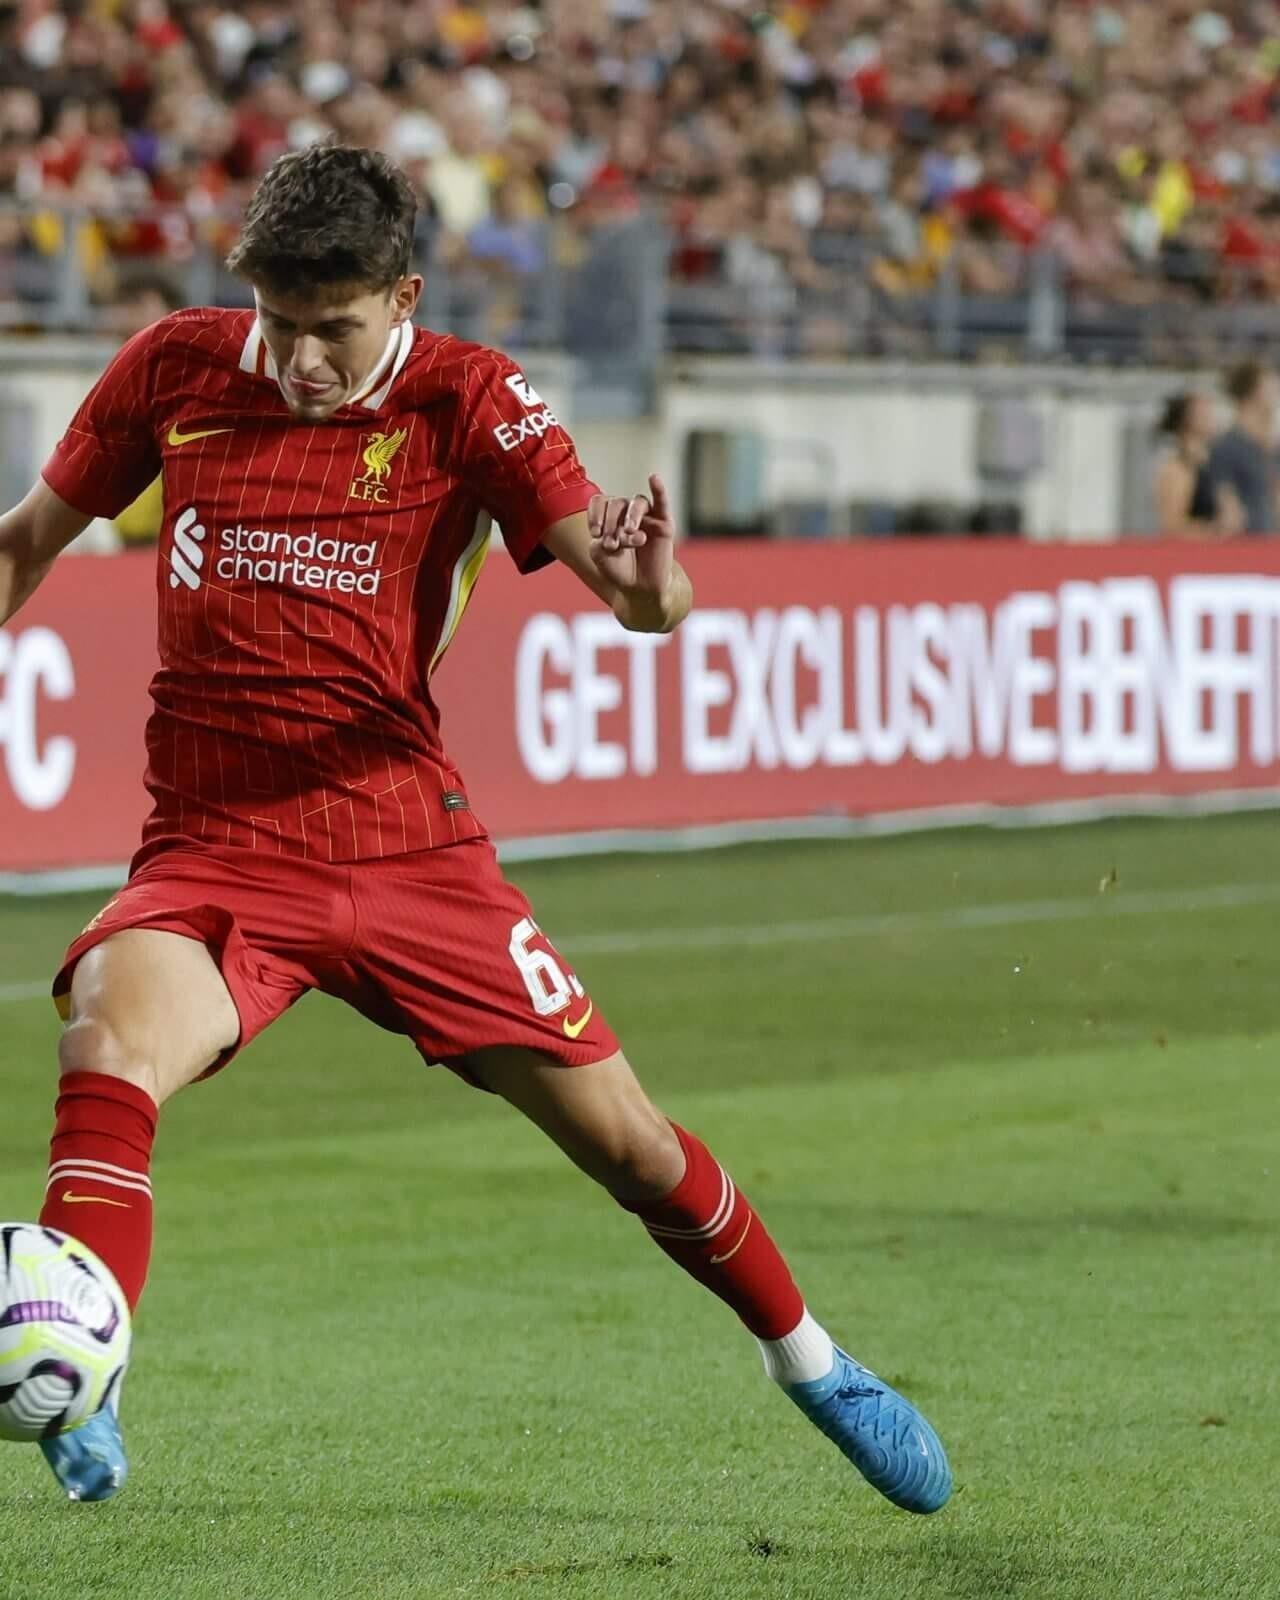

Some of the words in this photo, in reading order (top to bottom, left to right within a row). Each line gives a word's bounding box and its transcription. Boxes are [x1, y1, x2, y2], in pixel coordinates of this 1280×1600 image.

[216, 552, 381, 596] chartered
[220, 524, 377, 566] standard
[515, 612, 671, 783] GET
[681, 592, 1058, 775] EXCLUSIVE
[509, 915, 586, 1017] 6
